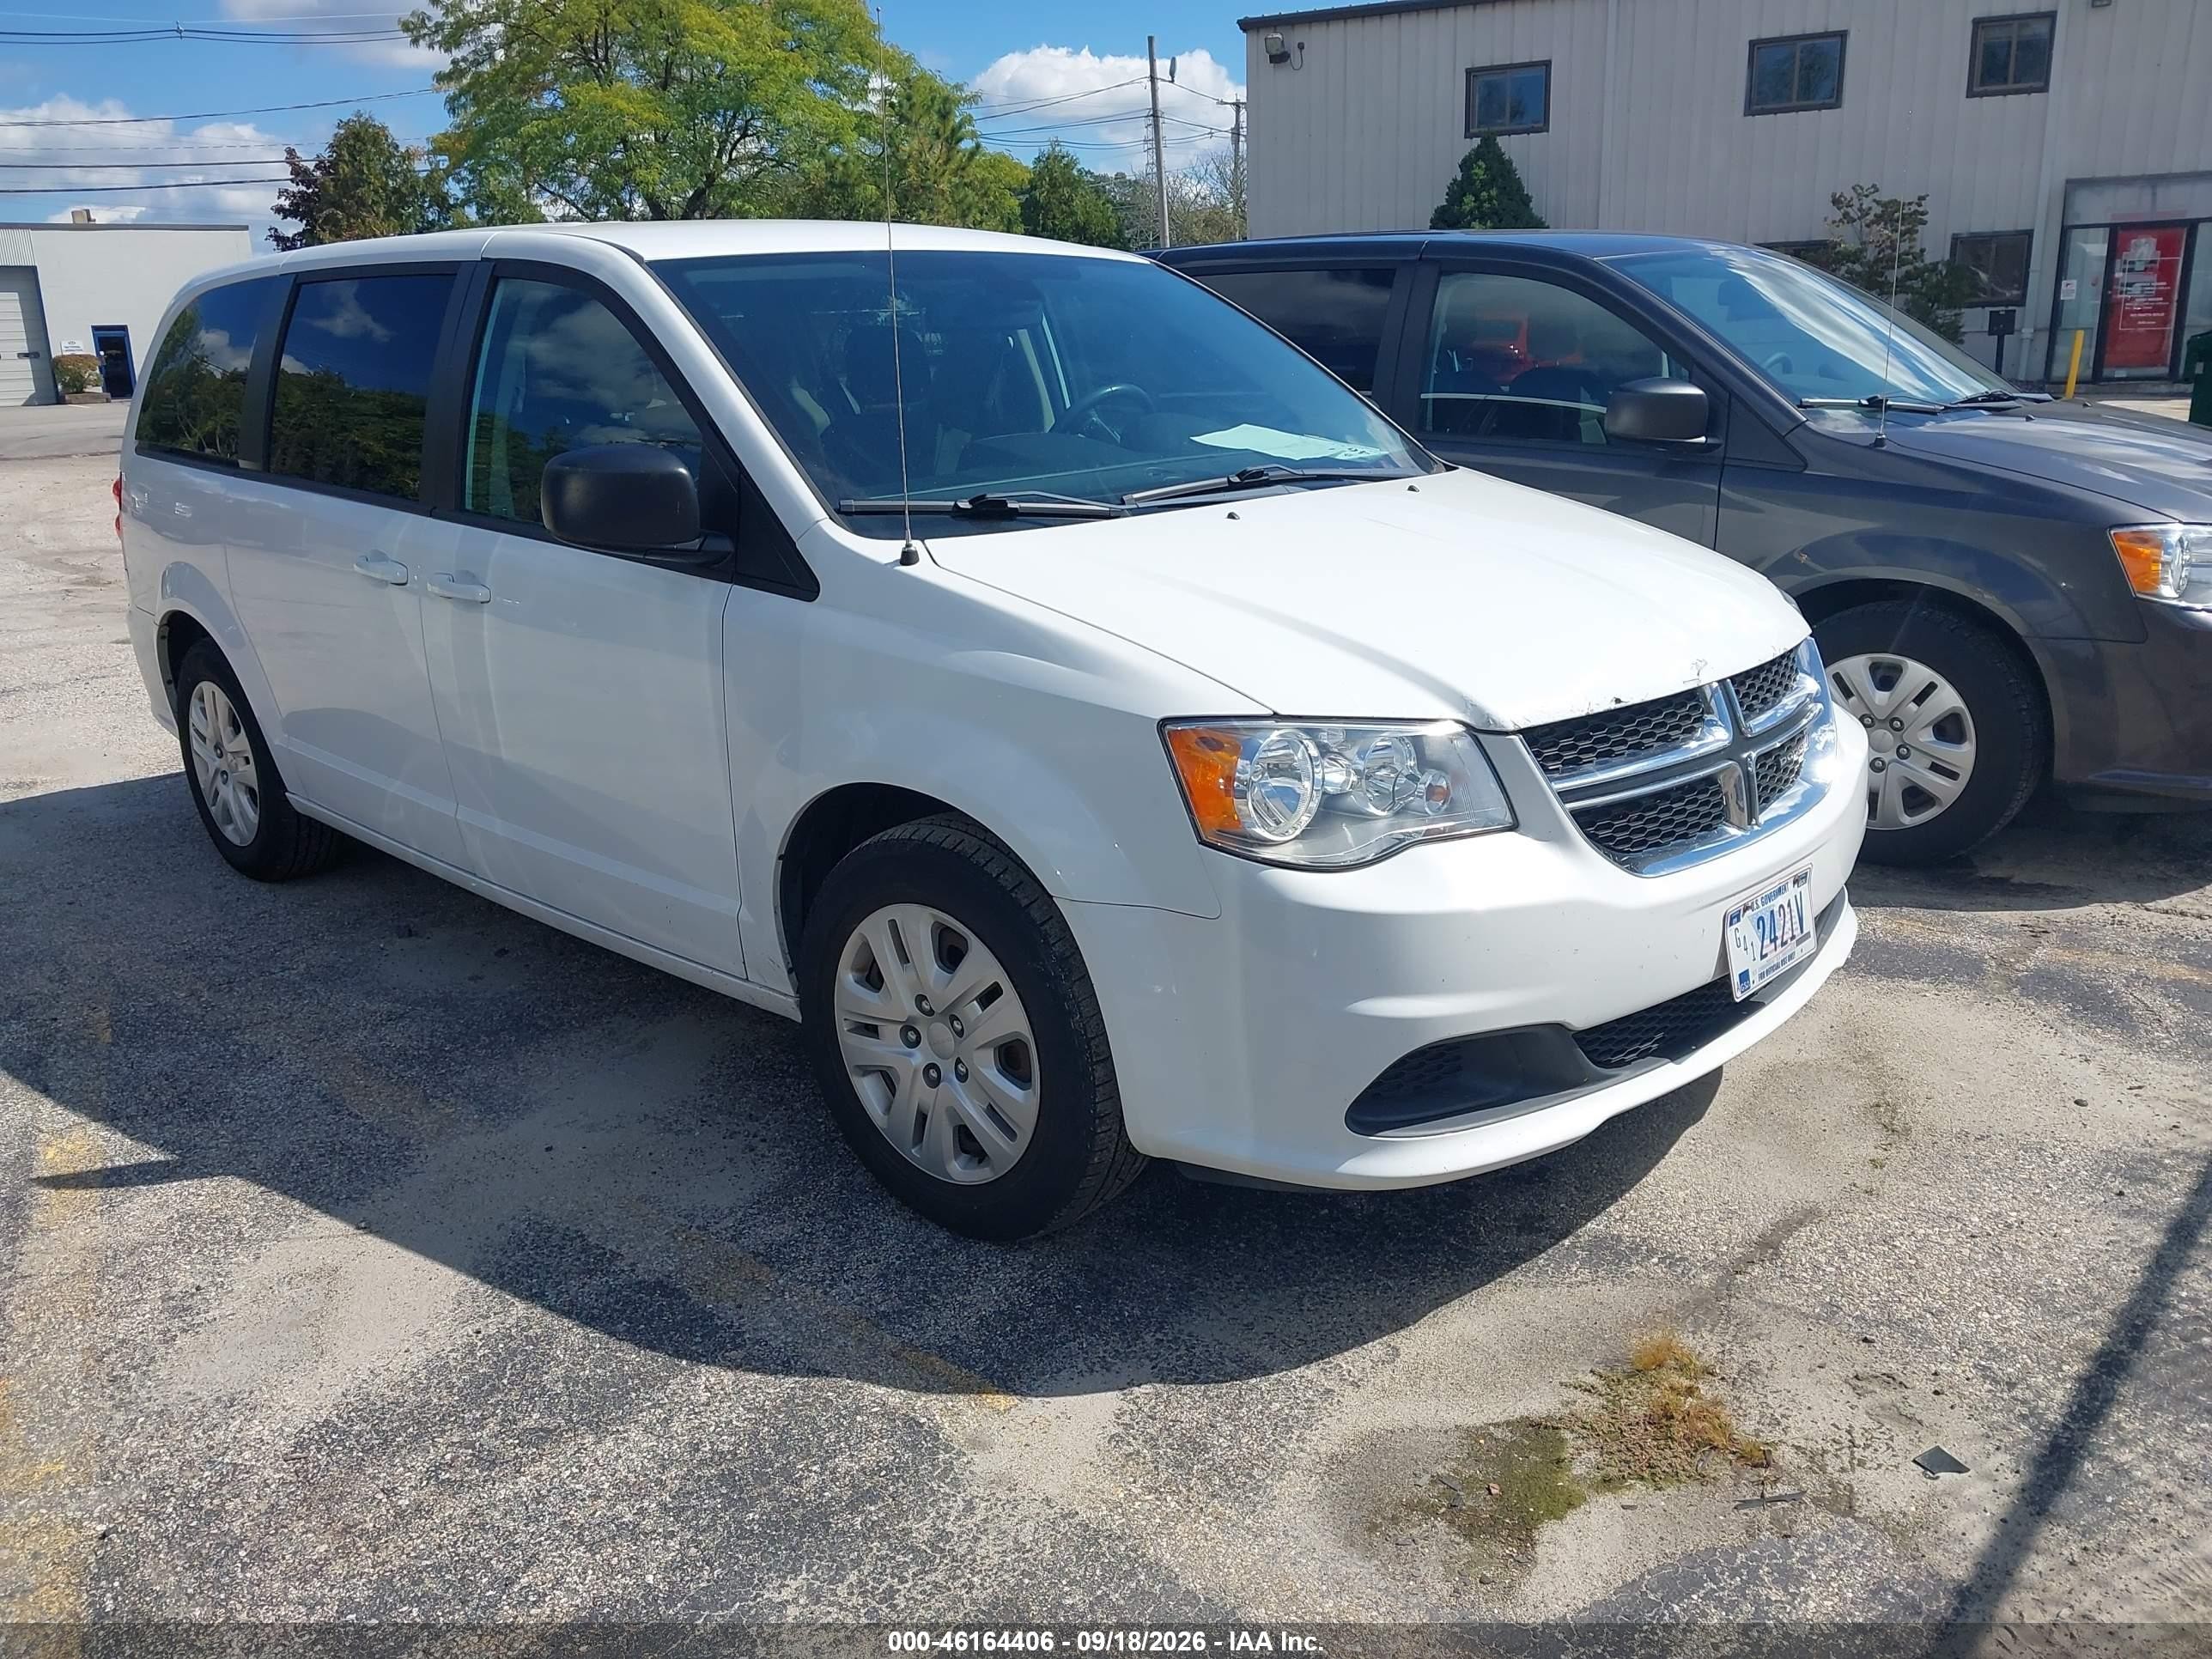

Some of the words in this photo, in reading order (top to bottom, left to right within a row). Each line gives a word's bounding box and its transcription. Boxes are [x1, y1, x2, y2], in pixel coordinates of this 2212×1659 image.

[1760, 882, 1790, 907] GOVERNMENT
[1756, 890, 1804, 961] 2421V
[1765, 961, 1781, 977] OFFICIAL
